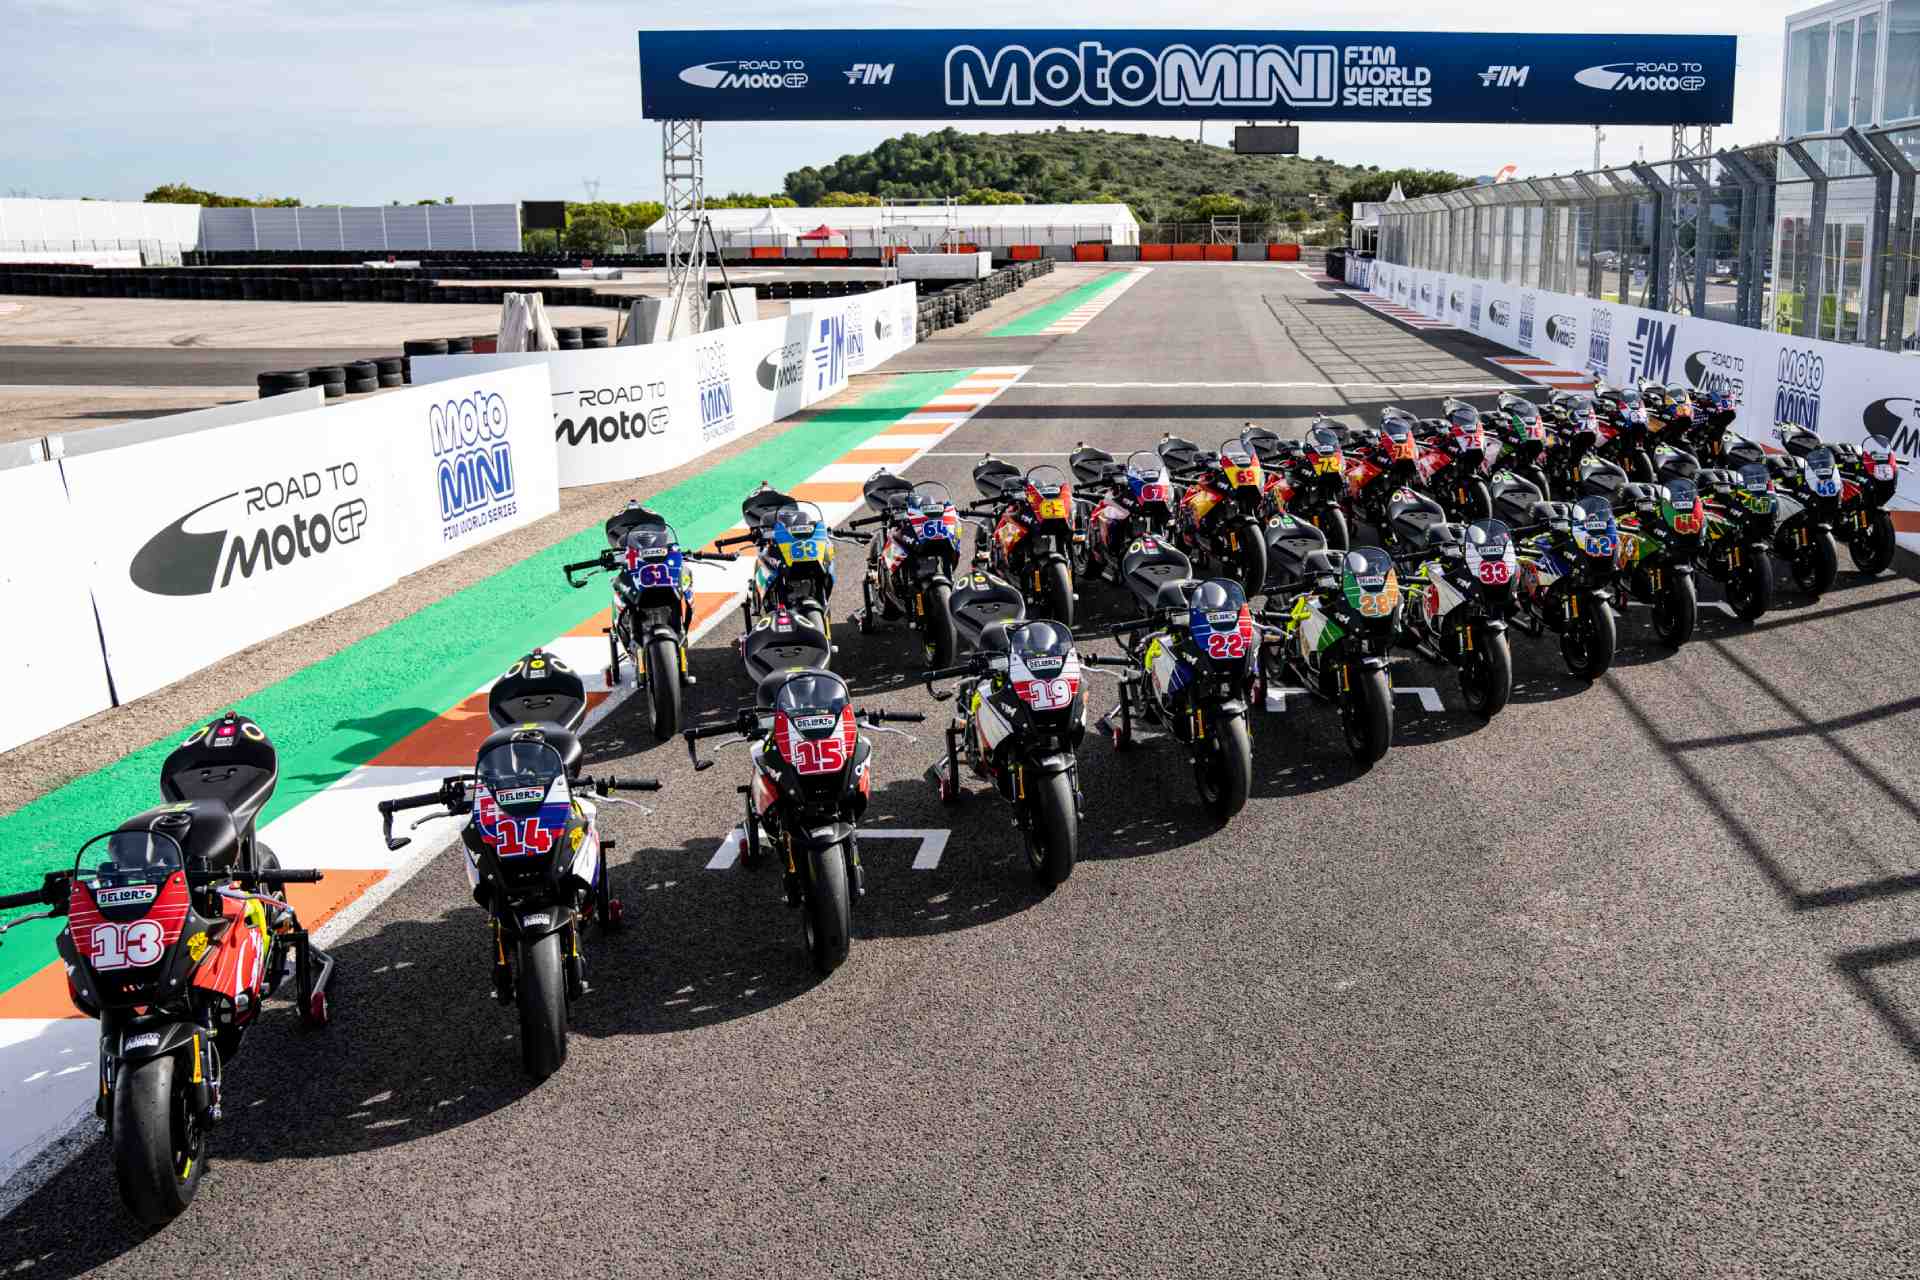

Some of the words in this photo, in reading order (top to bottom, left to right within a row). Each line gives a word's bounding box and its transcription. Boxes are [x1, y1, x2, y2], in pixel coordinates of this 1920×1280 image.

[738, 60, 781, 70] ROAD
[783, 60, 805, 70] TO
[1344, 46, 1396, 65] FIM
[1635, 62, 1678, 73] ROAD
[1682, 62, 1703, 73] TO
[720, 72, 809, 88] MotoGP
[842, 63, 896, 85] FIM
[1344, 66, 1431, 86] WORLD
[1477, 65, 1530, 87] FIM
[1615, 74, 1705, 91] MotoGP
[1343, 87, 1433, 107] SERIES
[812, 313, 845, 391] FIM
[1628, 317, 1677, 385] FIM
[1712, 352, 1731, 368] ROAD
[1734, 357, 1744, 372] TO
[1778, 347, 1824, 392] Moto
[579, 384, 644, 408] ROAD
[647, 381, 667, 399] TO
[699, 380, 735, 429] MINI
[1774, 385, 1821, 433] MINI
[429, 390, 508, 457] Moto
[244, 471, 322, 516] ROAD
[326, 461, 359, 491] TO
[438, 441, 515, 522] MINI
[443, 524, 460, 543] FIM
[460, 512, 488, 534] WORLD
[488, 501, 518, 523] SERIES
[922, 519, 948, 539] 64
[220, 497, 368, 588] MotoGP
[791, 539, 819, 561] 63
[1479, 561, 1510, 584] 33
[1208, 633, 1245, 659] 22
[1030, 679, 1072, 711] 19
[794, 738, 845, 775] 15
[496, 817, 552, 857] 14
[91, 919, 164, 971] 13
